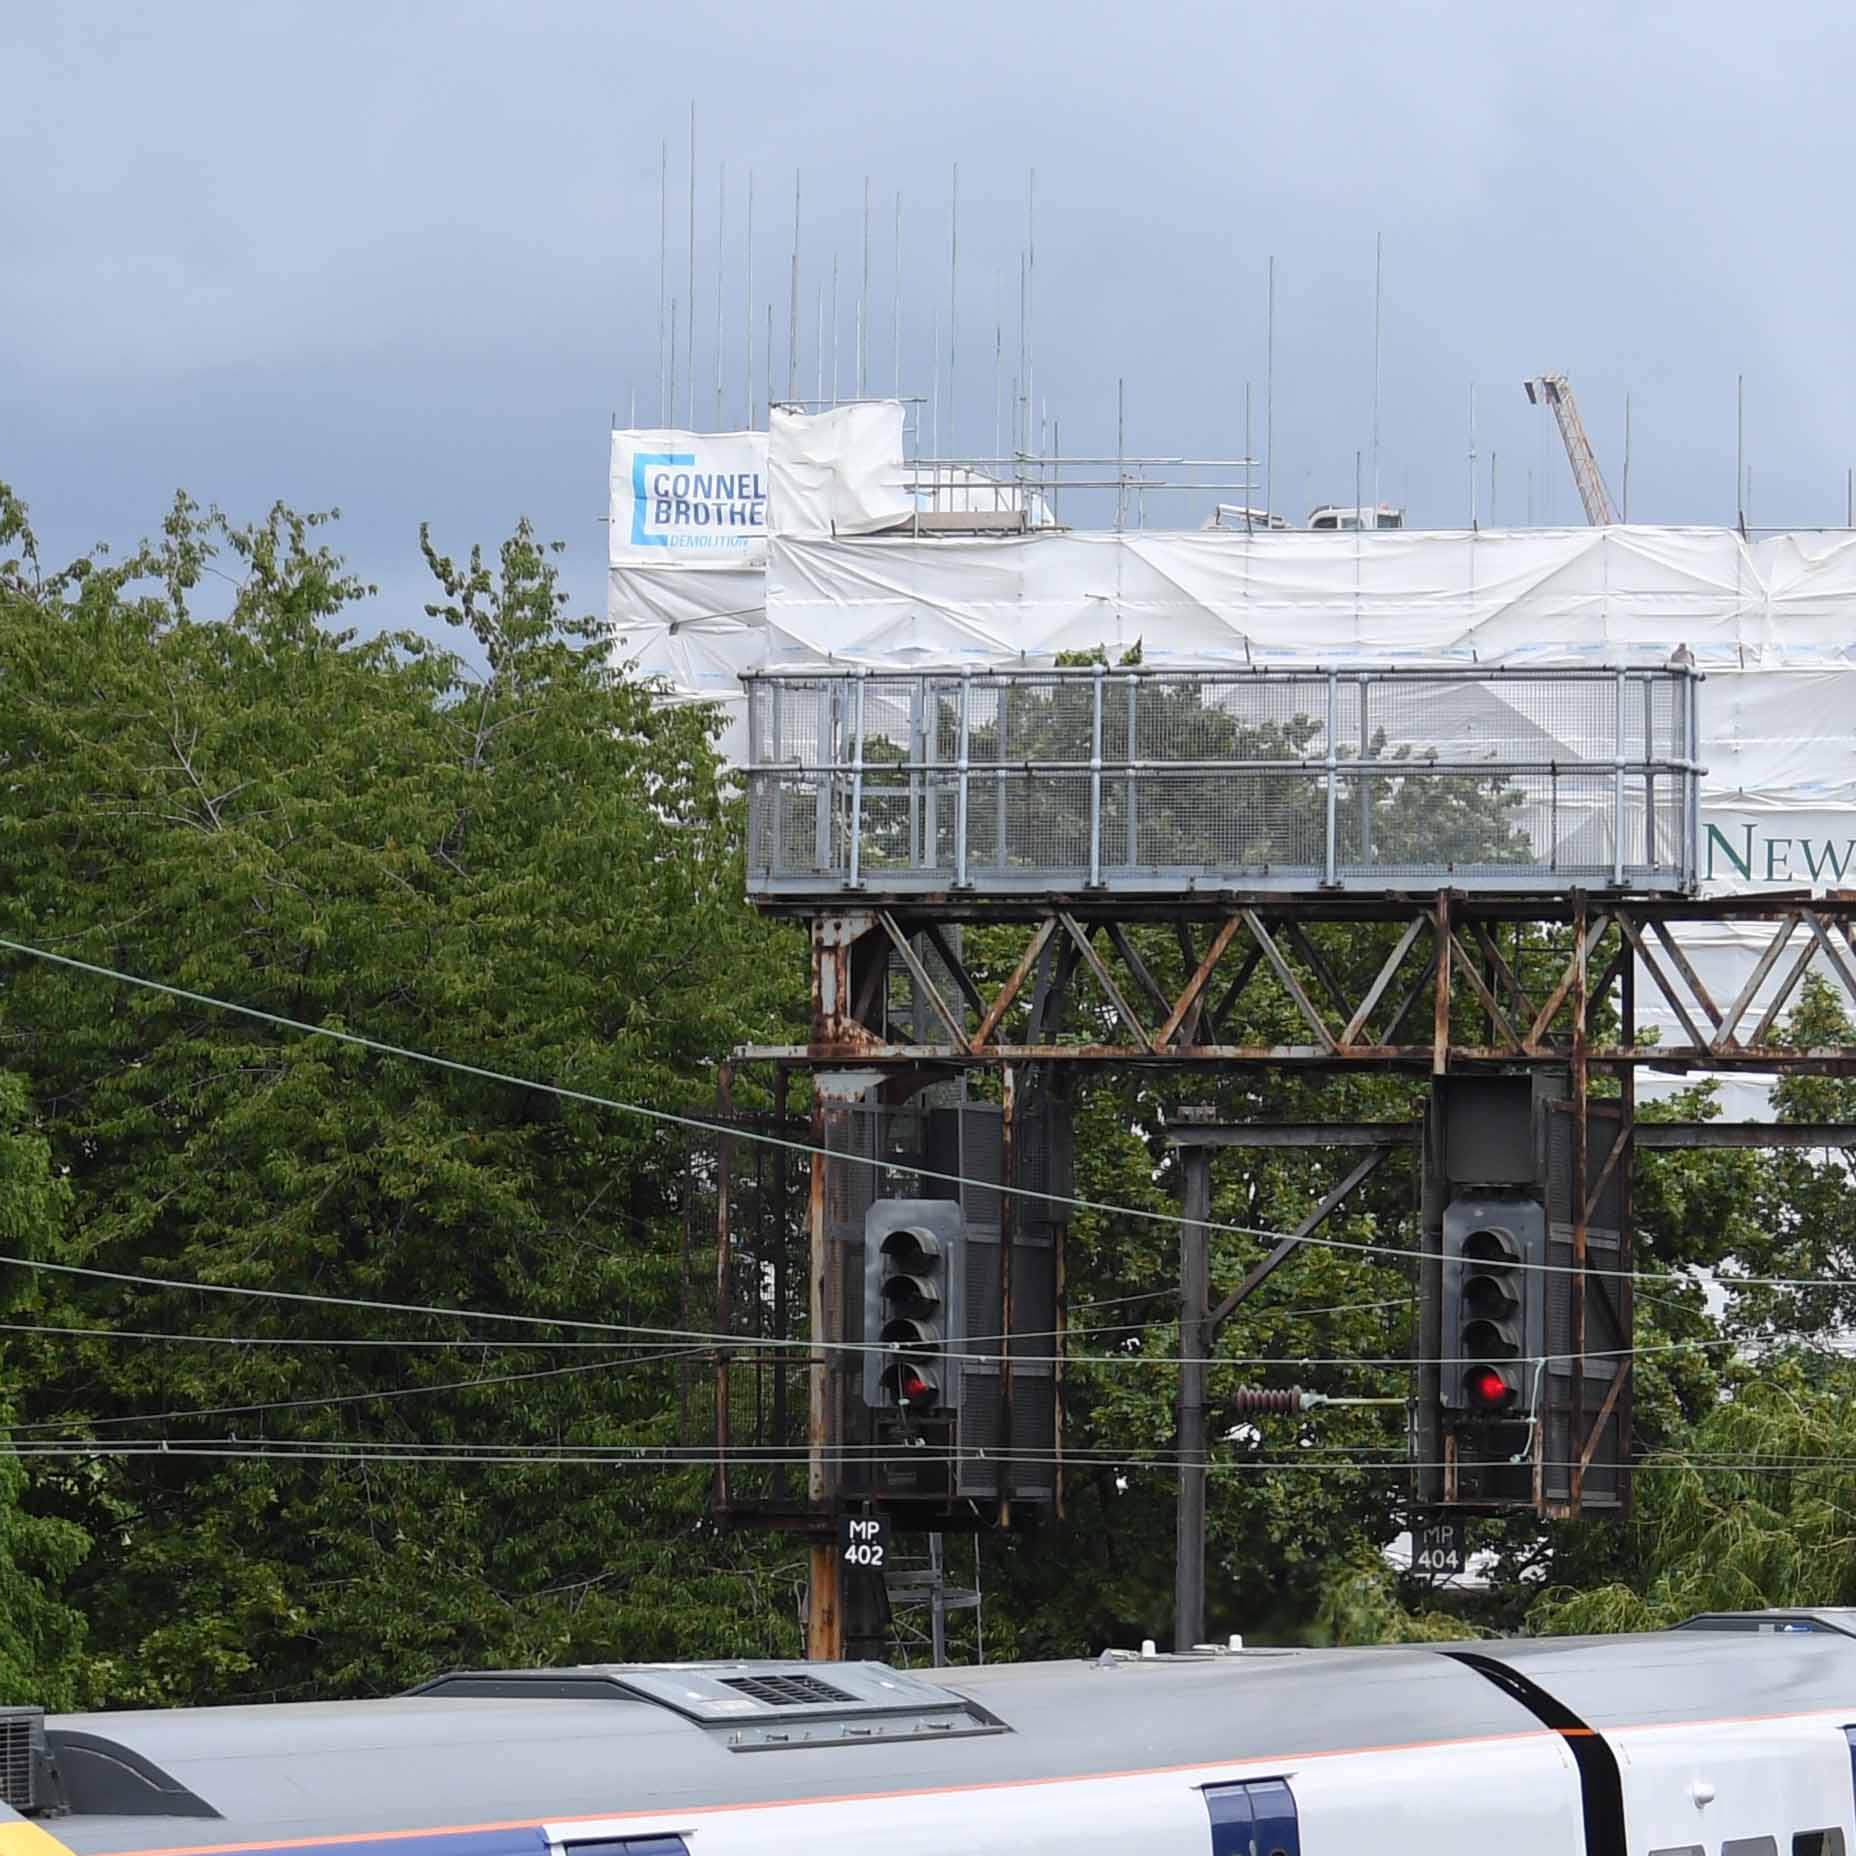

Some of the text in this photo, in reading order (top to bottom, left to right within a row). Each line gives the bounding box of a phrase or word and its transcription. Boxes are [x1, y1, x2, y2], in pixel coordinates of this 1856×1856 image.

[653, 473, 767, 500] CONNEL
[849, 1520, 880, 1541] MP
[1423, 1525, 1454, 1545] MP
[844, 1544, 884, 1566] 402
[1417, 1549, 1460, 1570] 404
